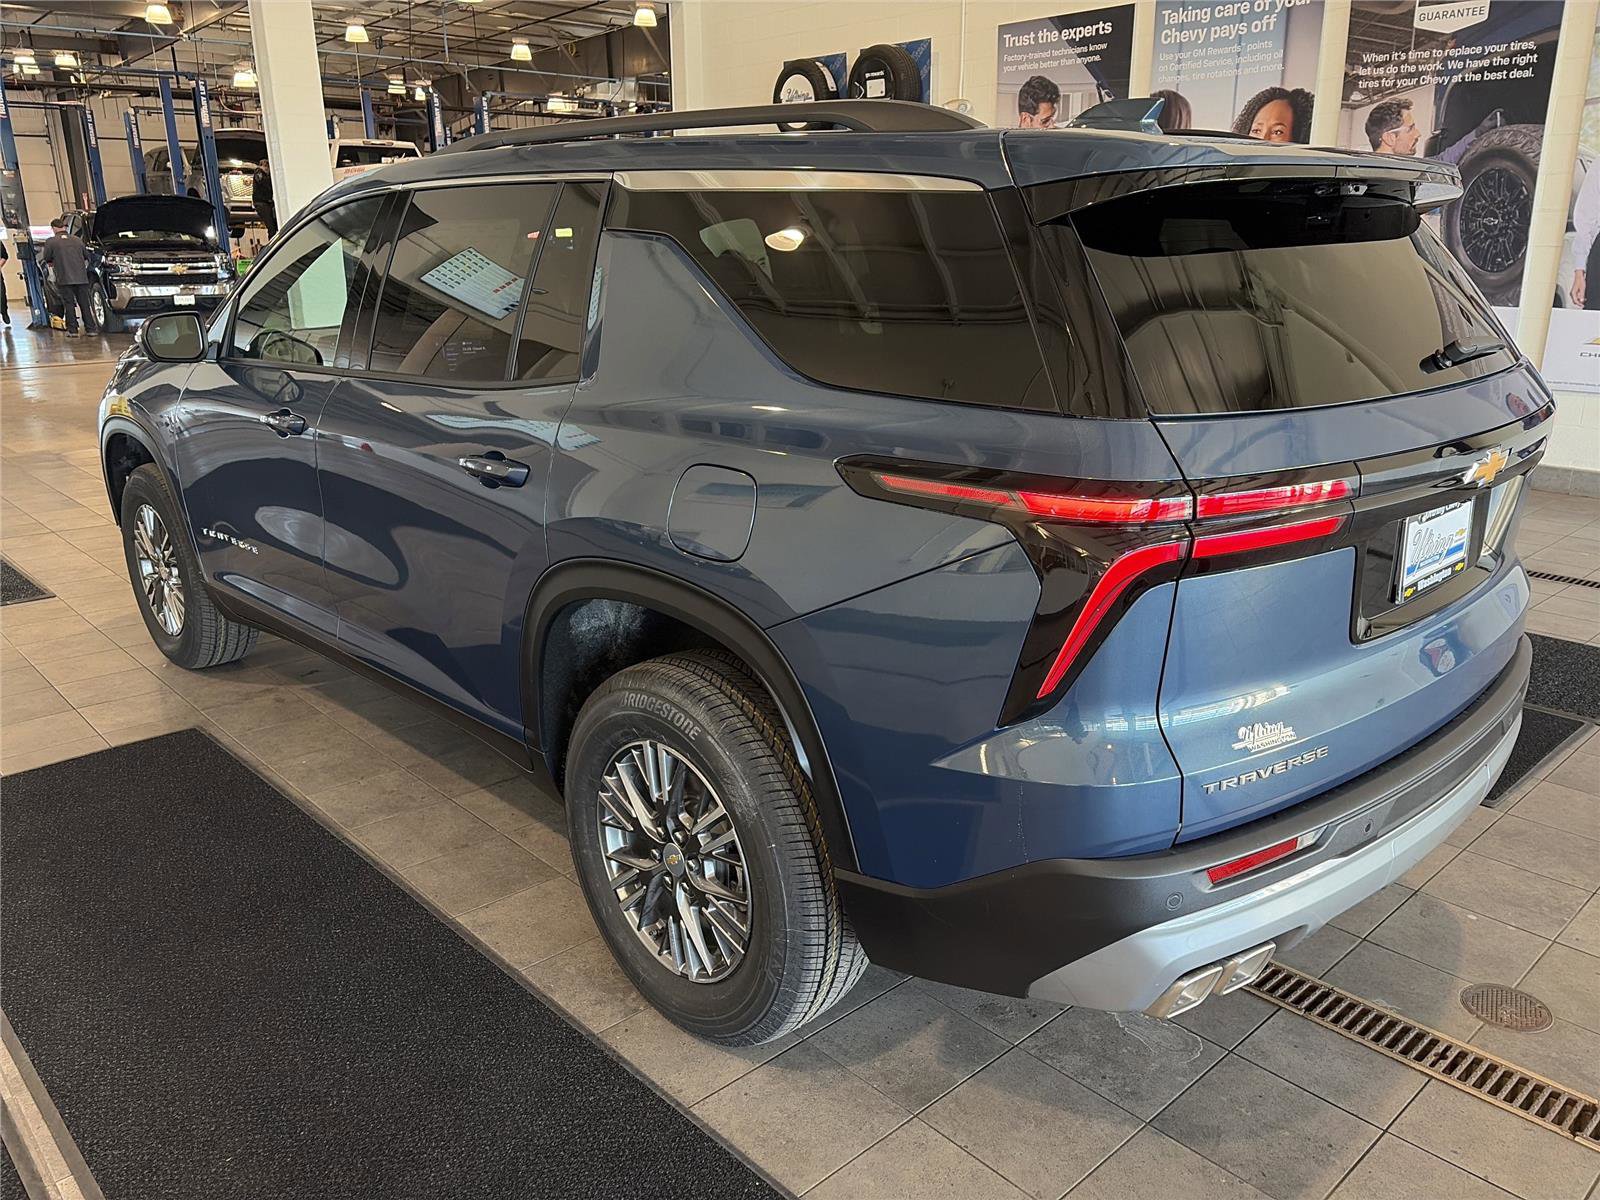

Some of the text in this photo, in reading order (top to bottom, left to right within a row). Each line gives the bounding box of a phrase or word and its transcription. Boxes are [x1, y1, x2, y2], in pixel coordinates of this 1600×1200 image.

[1161, 6, 1211, 25] Taking
[1214, 1, 1250, 18] care
[1254, 0, 1271, 12] of
[1419, 6, 1486, 21] GUARANTEE
[1003, 20, 1113, 48] Trust the experts
[1161, 14, 1277, 44] Chevy pays off
[1003, 42, 1108, 63] Factory-trained technicians know
[1158, 64, 1168, 72] on
[1169, 60, 1202, 71] Certified
[1235, 52, 1272, 64] including
[1273, 49, 1284, 59] oil
[1159, 52, 1174, 61] Use
[1174, 51, 1191, 61] your
[1192, 48, 1206, 57] GM
[1247, 40, 1273, 52] points
[1363, 52, 1389, 63] When
[1408, 49, 1430, 59] time
[1432, 48, 1443, 57] to
[1444, 45, 1482, 57] replace
[1484, 43, 1508, 55] your
[1510, 40, 1537, 51] tires,
[1003, 53, 1102, 73] your vehicle better than anyone.
[1192, 71, 1206, 80] tire
[1206, 68, 1242, 80] rotations
[1243, 65, 1259, 75] and
[1359, 53, 1538, 76] let us do the work. We have the right
[1359, 67, 1534, 89] tires for your Chevy at the best deal.
[621, 691, 702, 741] BRIDGESTONE
[1249, 733, 1297, 752] WASHINGTON
[1201, 745, 1329, 796] TRAVERSE
